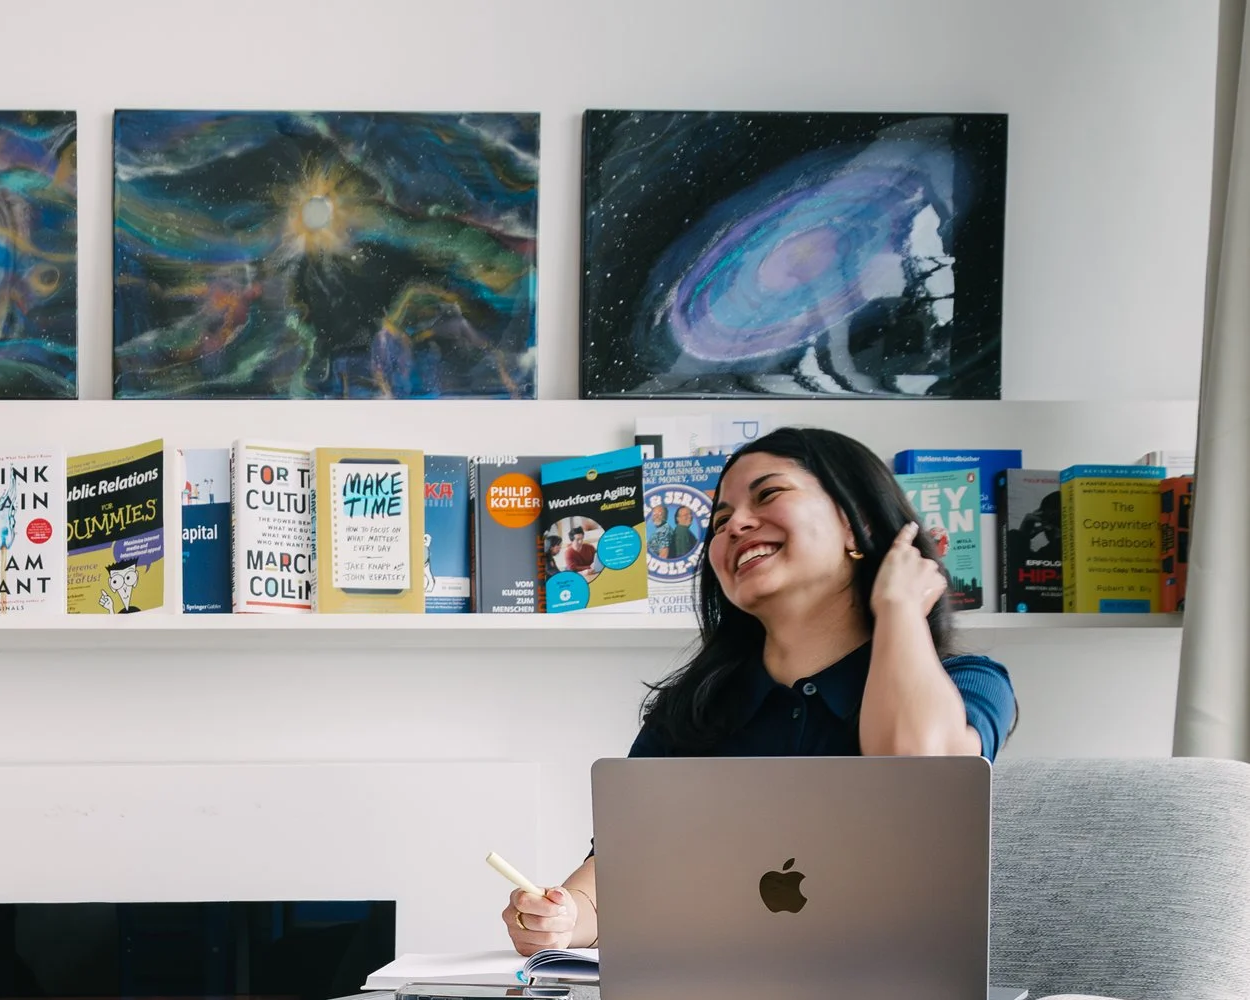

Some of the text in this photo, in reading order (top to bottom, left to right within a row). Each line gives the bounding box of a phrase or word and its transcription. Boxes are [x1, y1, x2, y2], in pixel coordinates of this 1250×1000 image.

[473, 455, 518, 468] campus
[941, 455, 981, 463] Handbücher
[246, 464, 289, 485] FOR
[667, 467, 704, 475] BUSINESS
[706, 465, 723, 474] AND
[98, 468, 158, 495] Relations
[342, 472, 403, 497] MAKE
[658, 475, 689, 484] MONEY,
[490, 486, 532, 497] PHILIP
[490, 498, 541, 508] KOTLER
[548, 486, 636, 510] Workforce Agility
[101, 502, 114, 511] FOR
[344, 496, 401, 519] TIME
[600, 499, 635, 511] dummies
[1112, 502, 1134, 513] The
[182, 524, 218, 544] apital
[1091, 537, 1156, 550] Handbook
[343, 562, 364, 570] JAKE
[368, 562, 391, 570] KNAPP
[87, 573, 101, 583] Us!
[343, 573, 365, 581] JOHN
[515, 580, 534, 588] VOM
[1096, 584, 1124, 592] Robert
[186, 603, 207, 611] Springer
